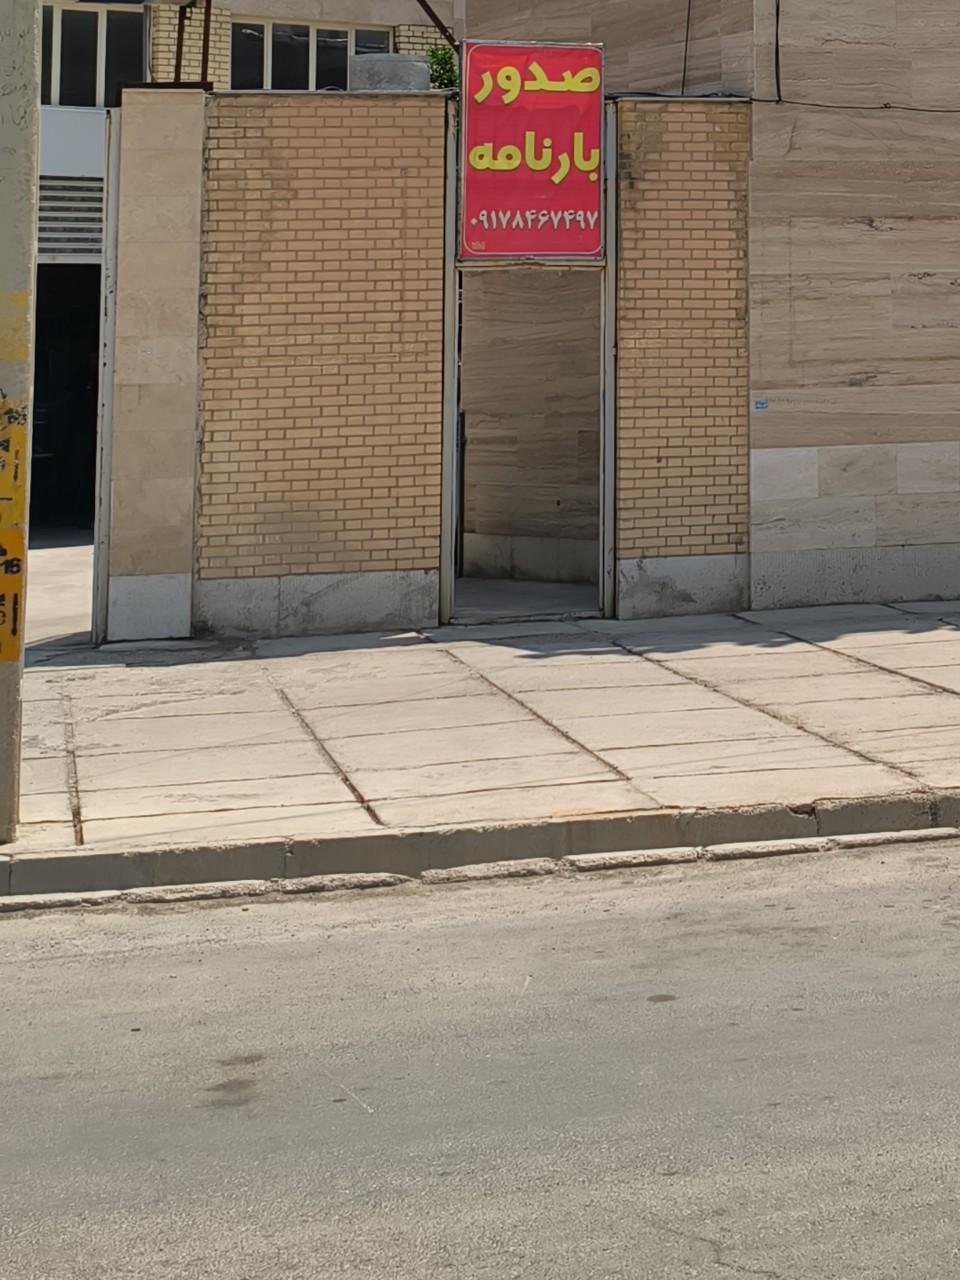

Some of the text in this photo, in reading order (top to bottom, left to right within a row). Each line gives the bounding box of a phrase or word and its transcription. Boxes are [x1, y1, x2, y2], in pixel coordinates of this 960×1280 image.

[473, 61, 601, 104] صدور
[468, 131, 600, 184] بارنامه
[470, 209, 599, 230] ۰۹۱۷۸۴۶۷۴۹۷
